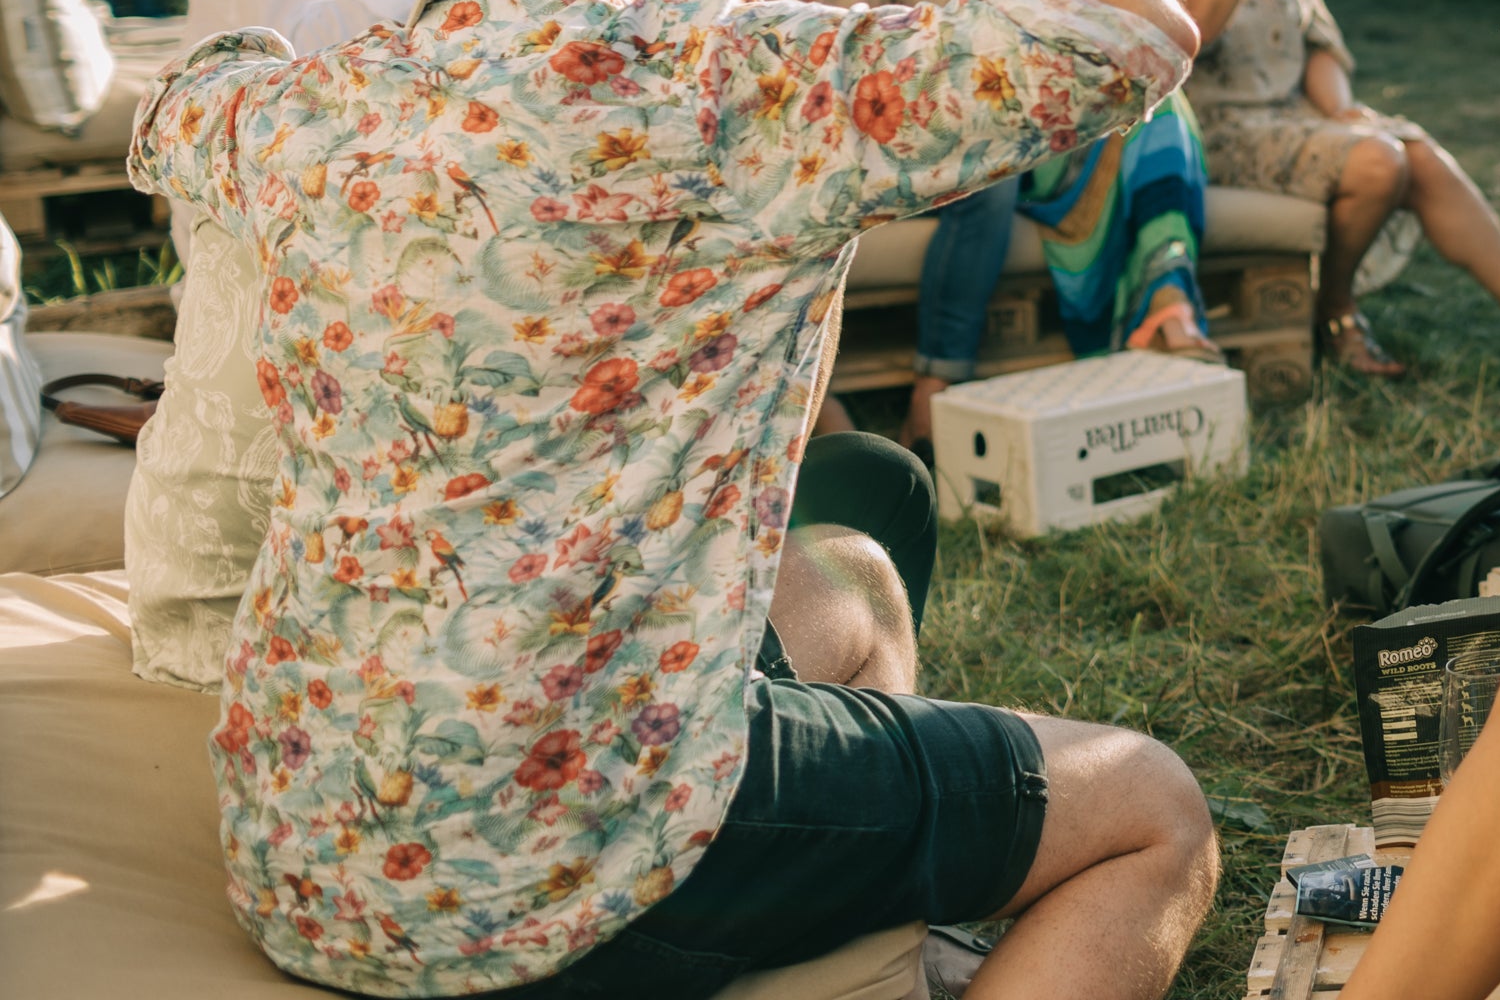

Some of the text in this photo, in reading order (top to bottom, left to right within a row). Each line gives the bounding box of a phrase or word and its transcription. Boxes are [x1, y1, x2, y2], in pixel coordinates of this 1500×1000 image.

[1085, 404, 1204, 453] ChariTea
[1378, 644, 1433, 668] Romeo
[1381, 666, 1406, 675] WILD
[1407, 661, 1437, 673] ROOTS
[1359, 898, 1369, 919] Wenn
[1370, 891, 1380, 920] schaden
